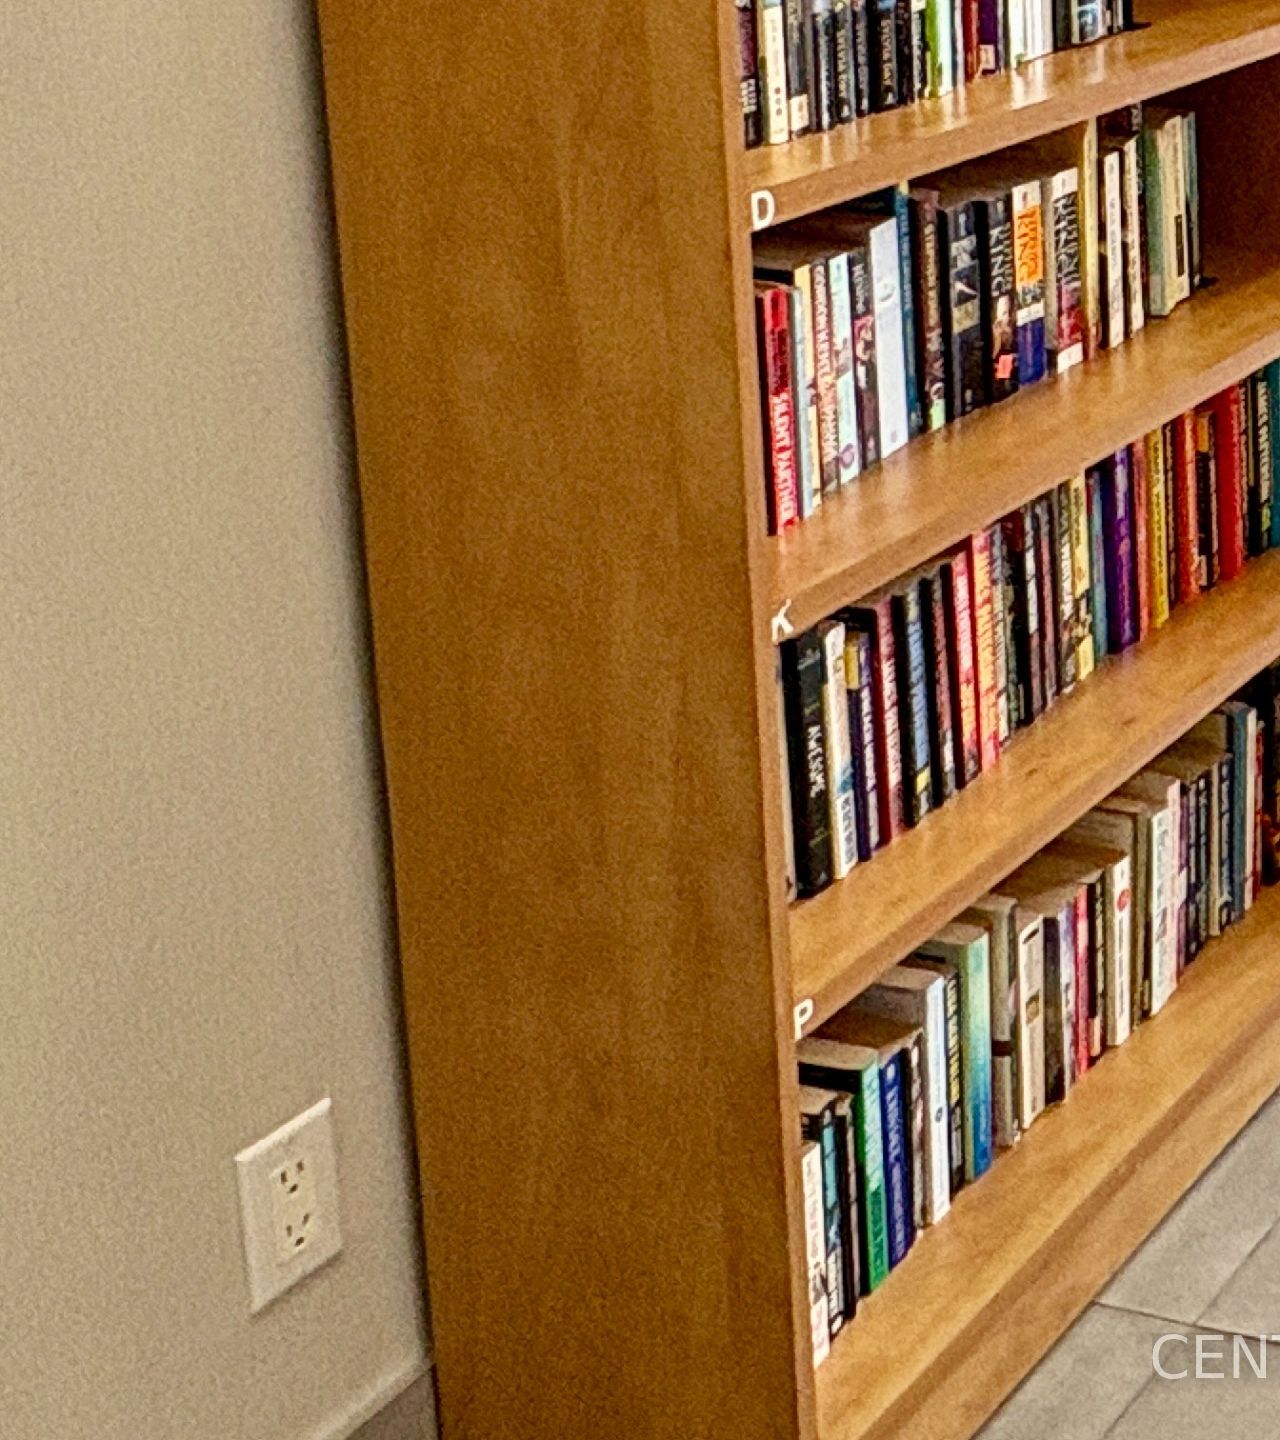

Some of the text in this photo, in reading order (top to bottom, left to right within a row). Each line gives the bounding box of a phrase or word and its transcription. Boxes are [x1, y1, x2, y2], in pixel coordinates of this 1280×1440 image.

[750, 190, 775, 232] D
[988, 223, 1006, 299] KING
[793, 998, 814, 1041] P
